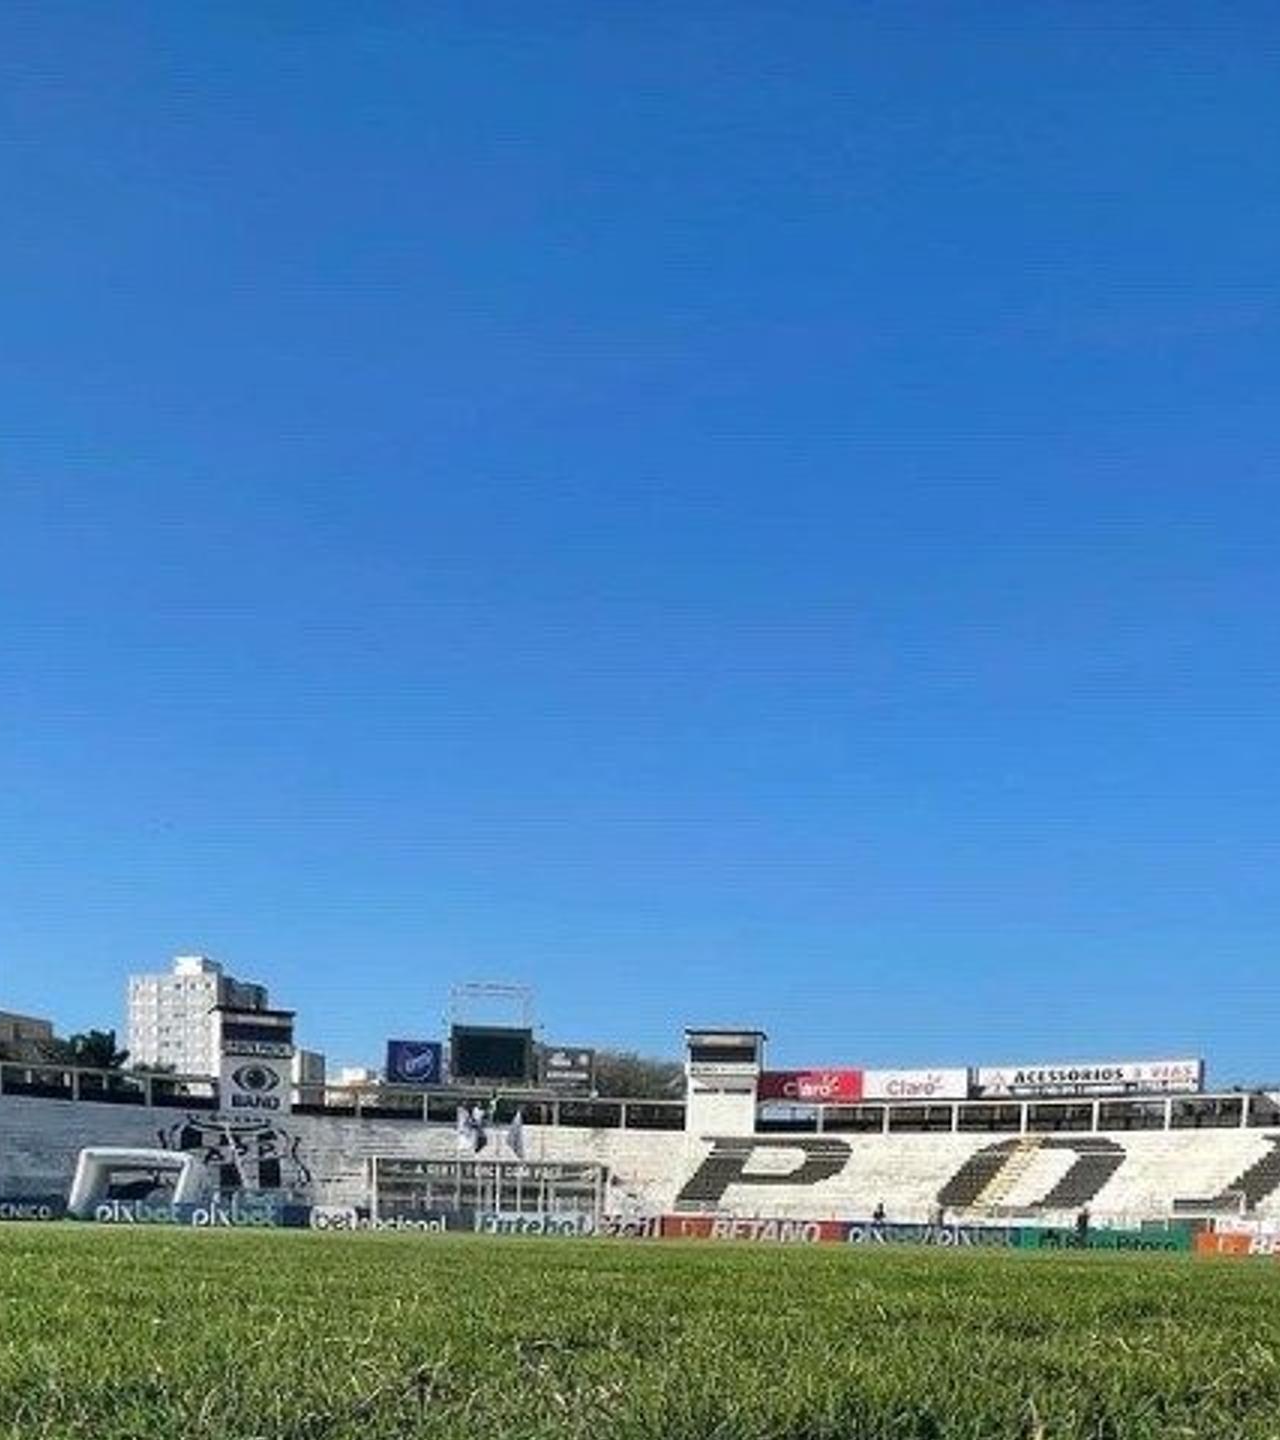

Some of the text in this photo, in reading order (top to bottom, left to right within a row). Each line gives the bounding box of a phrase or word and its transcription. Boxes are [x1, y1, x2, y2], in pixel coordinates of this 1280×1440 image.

[783, 1078, 832, 1096] Claro
[886, 1077, 935, 1096] Claro
[231, 1094, 280, 1110] BAND
[96, 1200, 178, 1223] pixbet
[192, 1194, 276, 1226] pixbet
